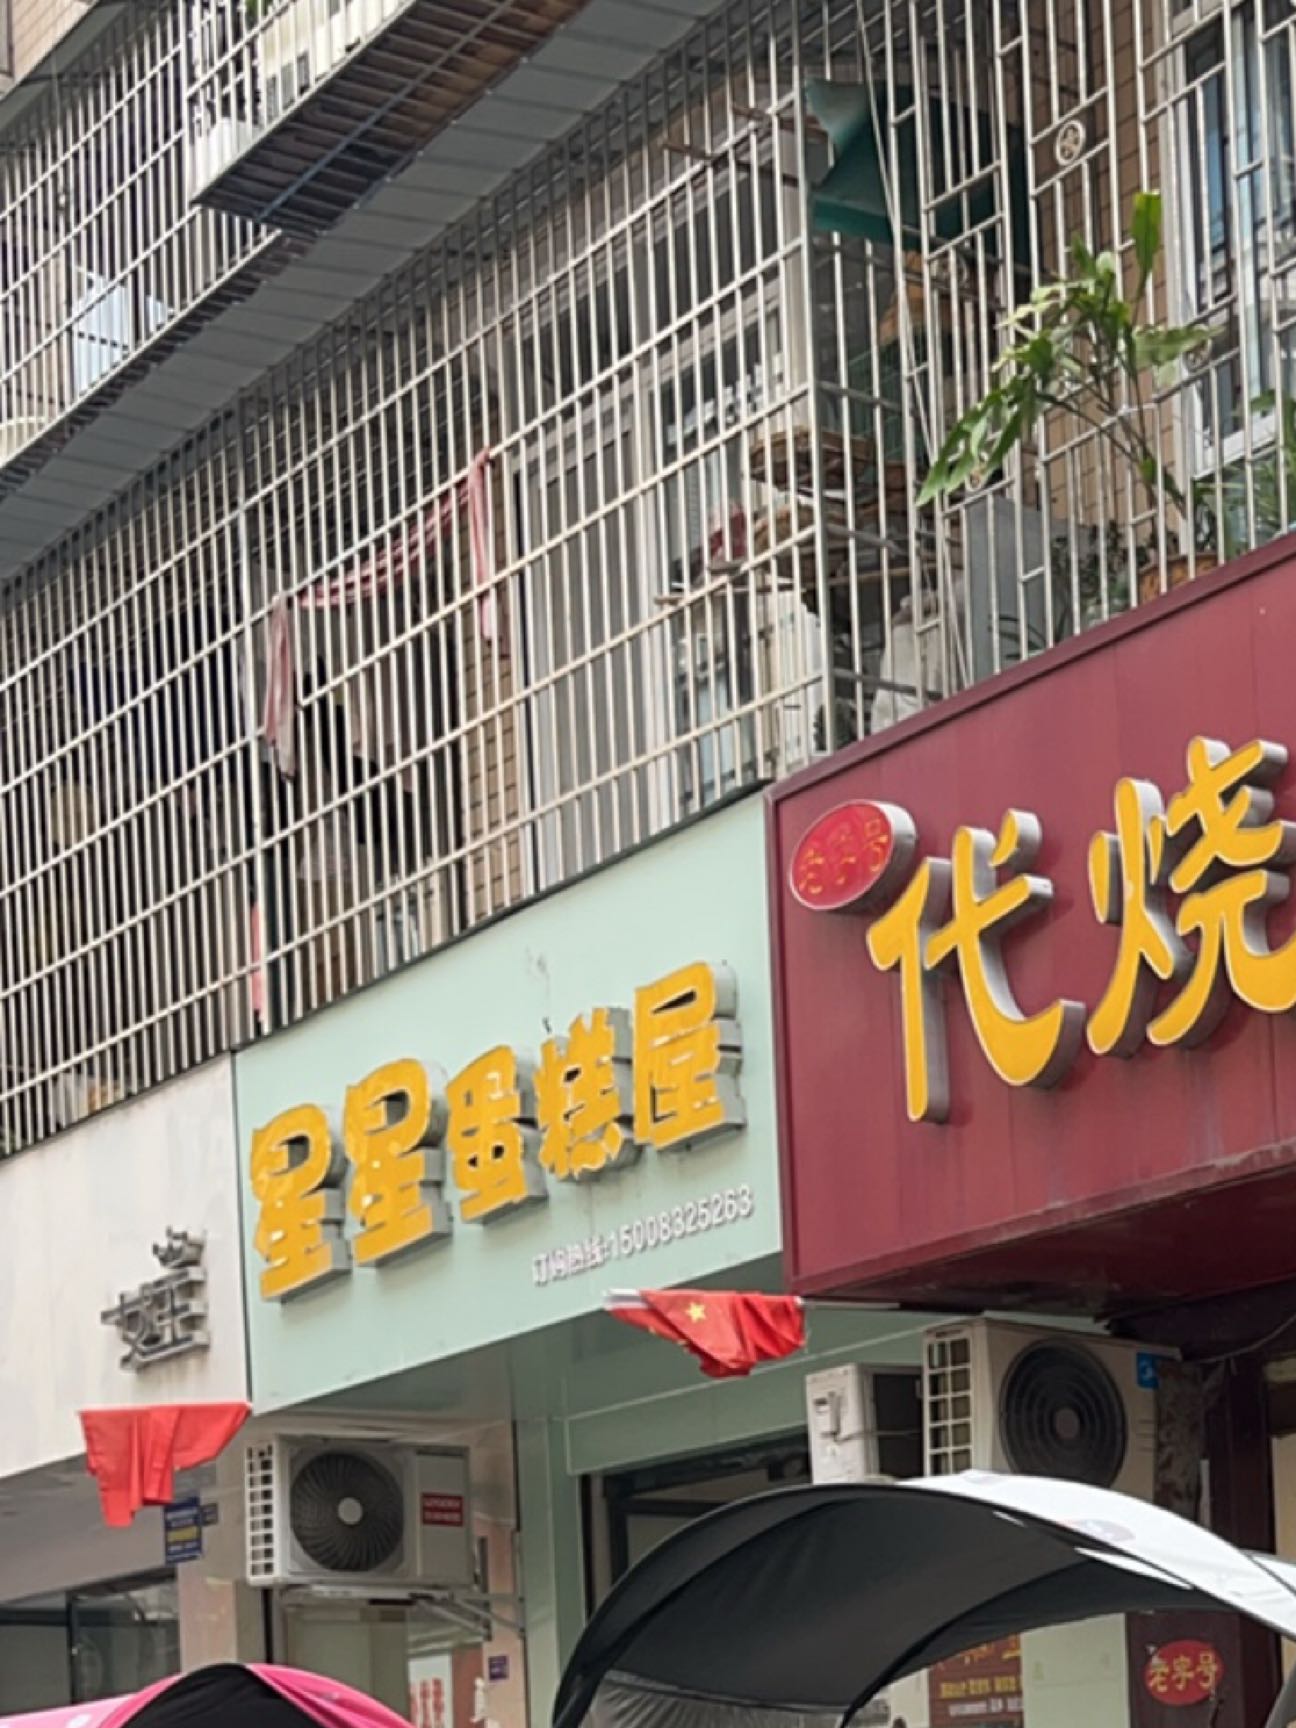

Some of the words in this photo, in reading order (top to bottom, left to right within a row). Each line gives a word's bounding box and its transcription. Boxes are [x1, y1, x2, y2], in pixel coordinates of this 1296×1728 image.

[249, 960, 744, 1303] 星星蛋糕屋
